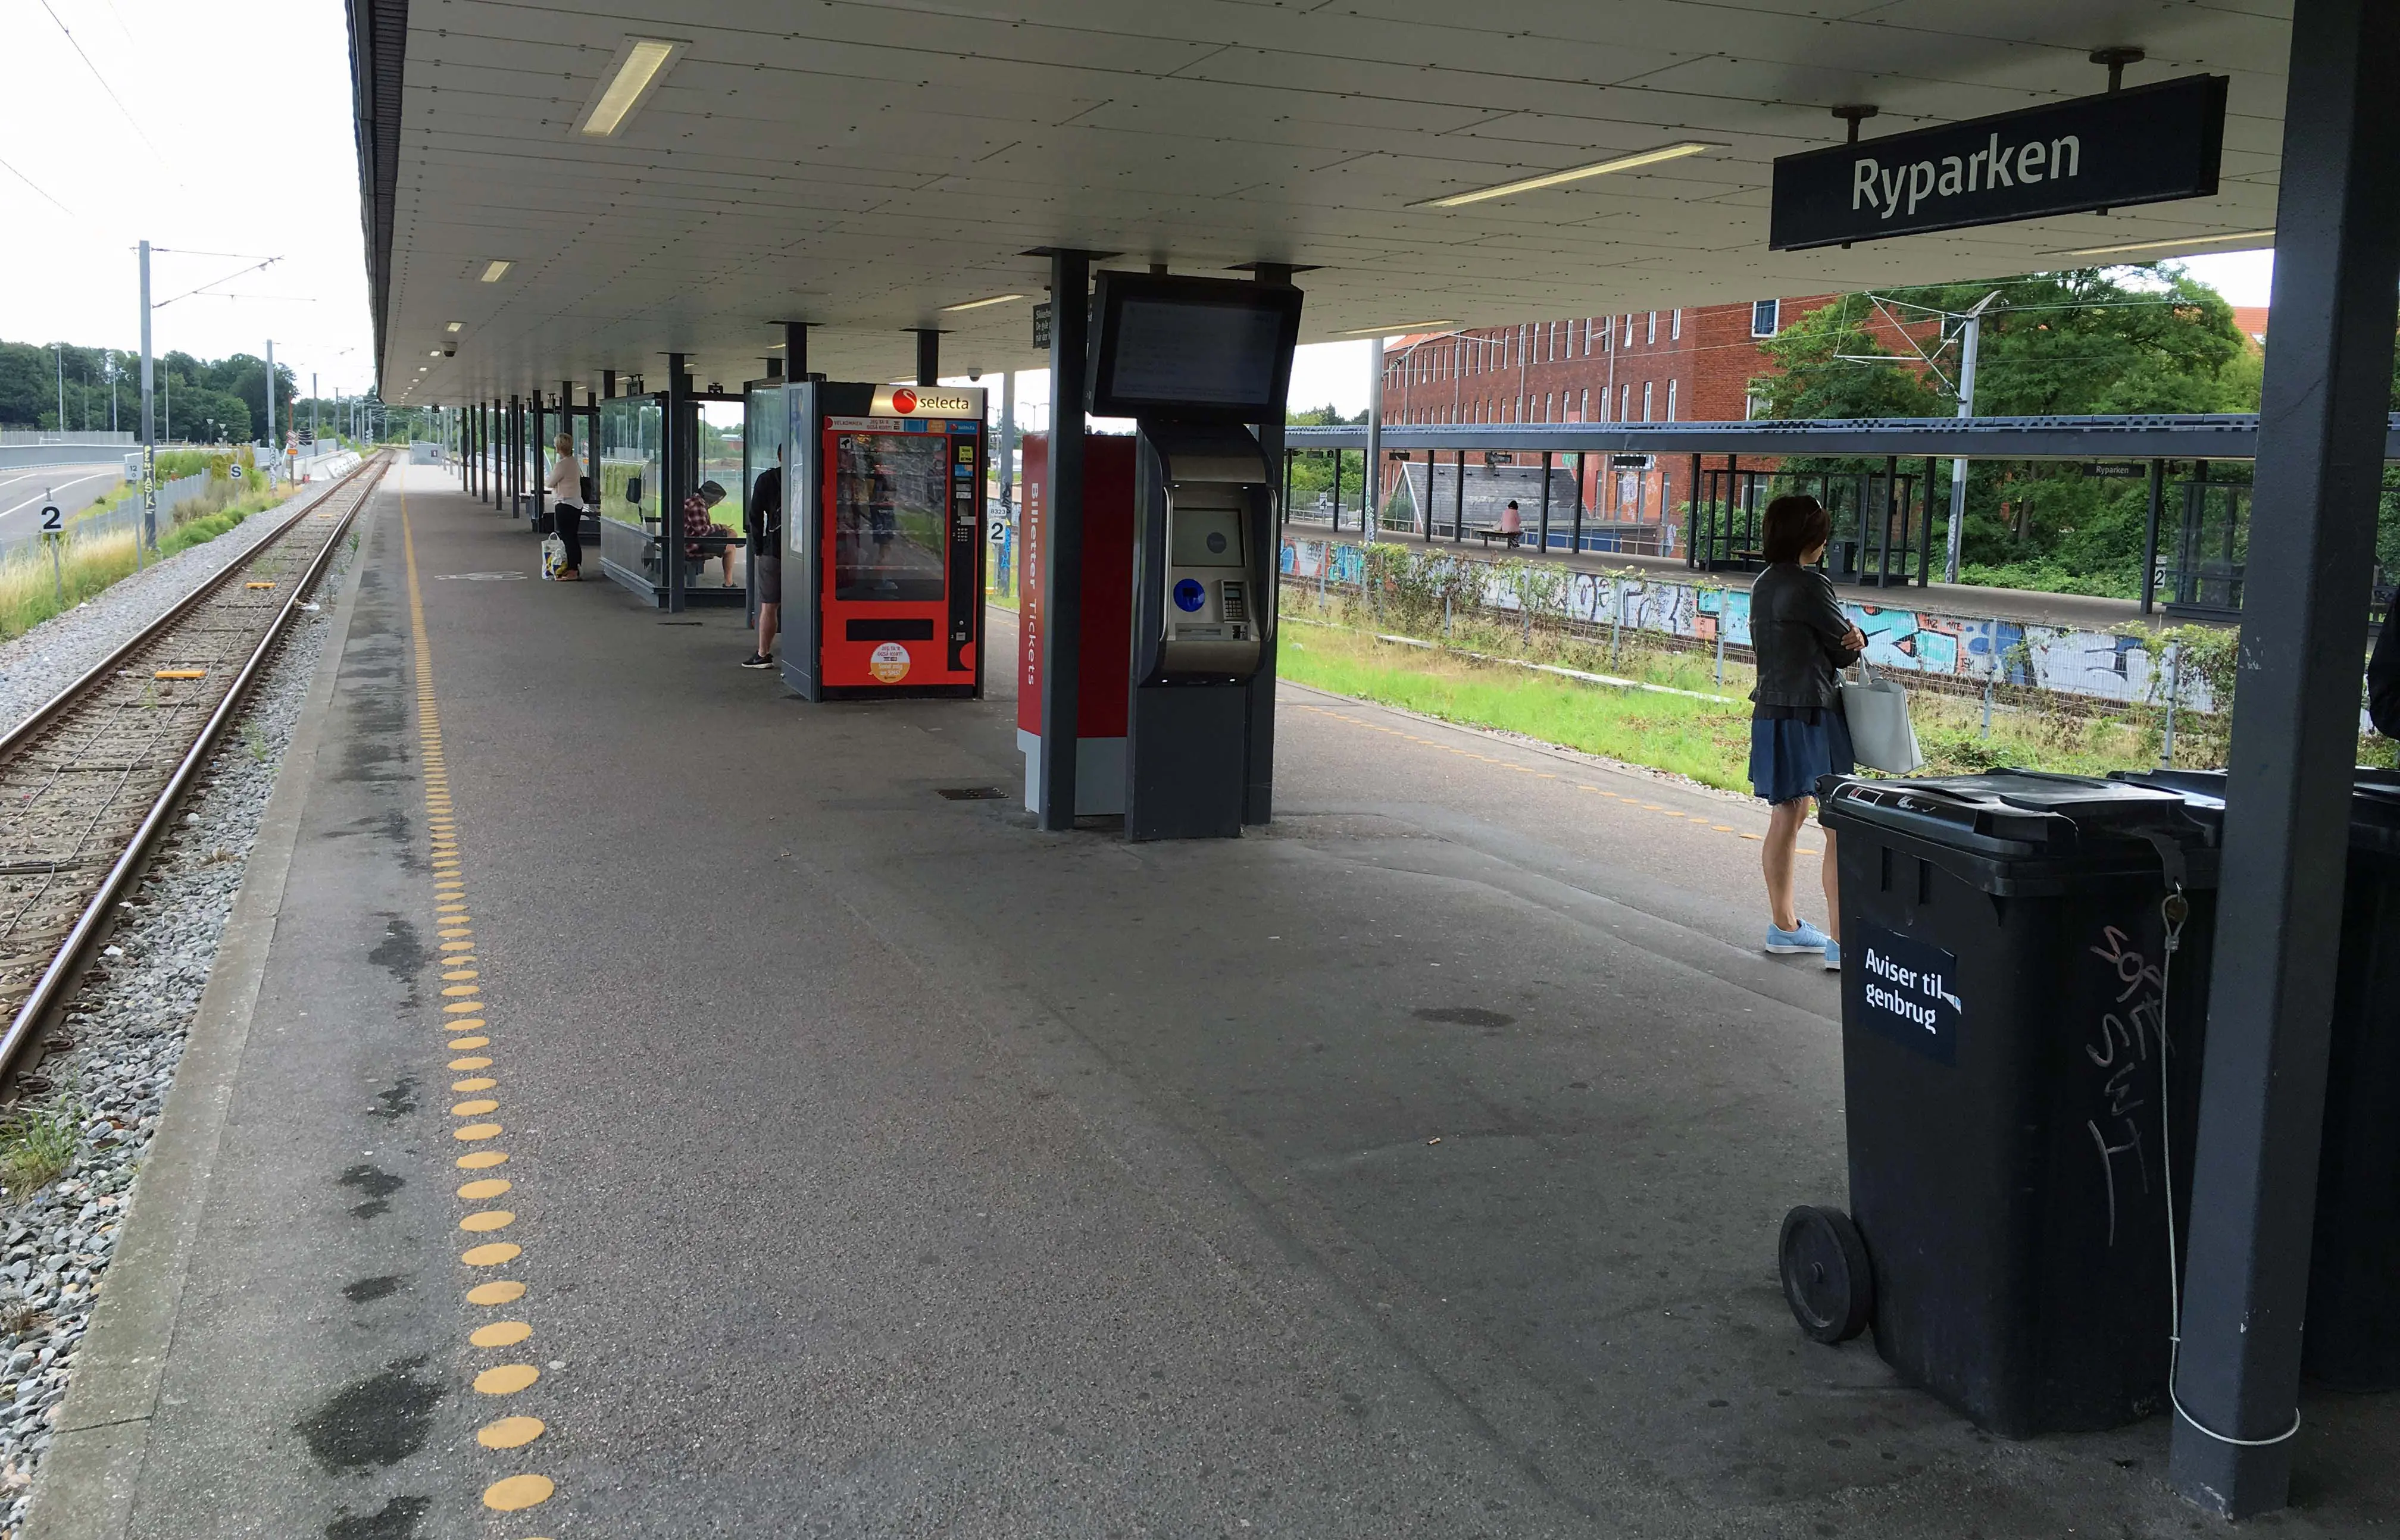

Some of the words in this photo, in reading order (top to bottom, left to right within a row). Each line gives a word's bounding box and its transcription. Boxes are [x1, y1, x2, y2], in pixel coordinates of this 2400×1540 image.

[1852, 133, 2080, 219] Ryparken
[920, 396, 969, 409] selecta
[231, 466, 241, 477] S
[2095, 465, 2129, 475] Ryparken
[1320, 500, 1327, 509] 4
[41, 506, 62, 529] 2
[991, 522, 1004, 540] 2
[1030, 483, 1039, 590] Billetter
[2154, 569, 2164, 586] 2
[1027, 598, 1037, 686] Tickets
[1865, 947, 1917, 989] Aviser
[1922, 973, 1942, 1000] til
[1865, 983, 1936, 1035] genbrug
